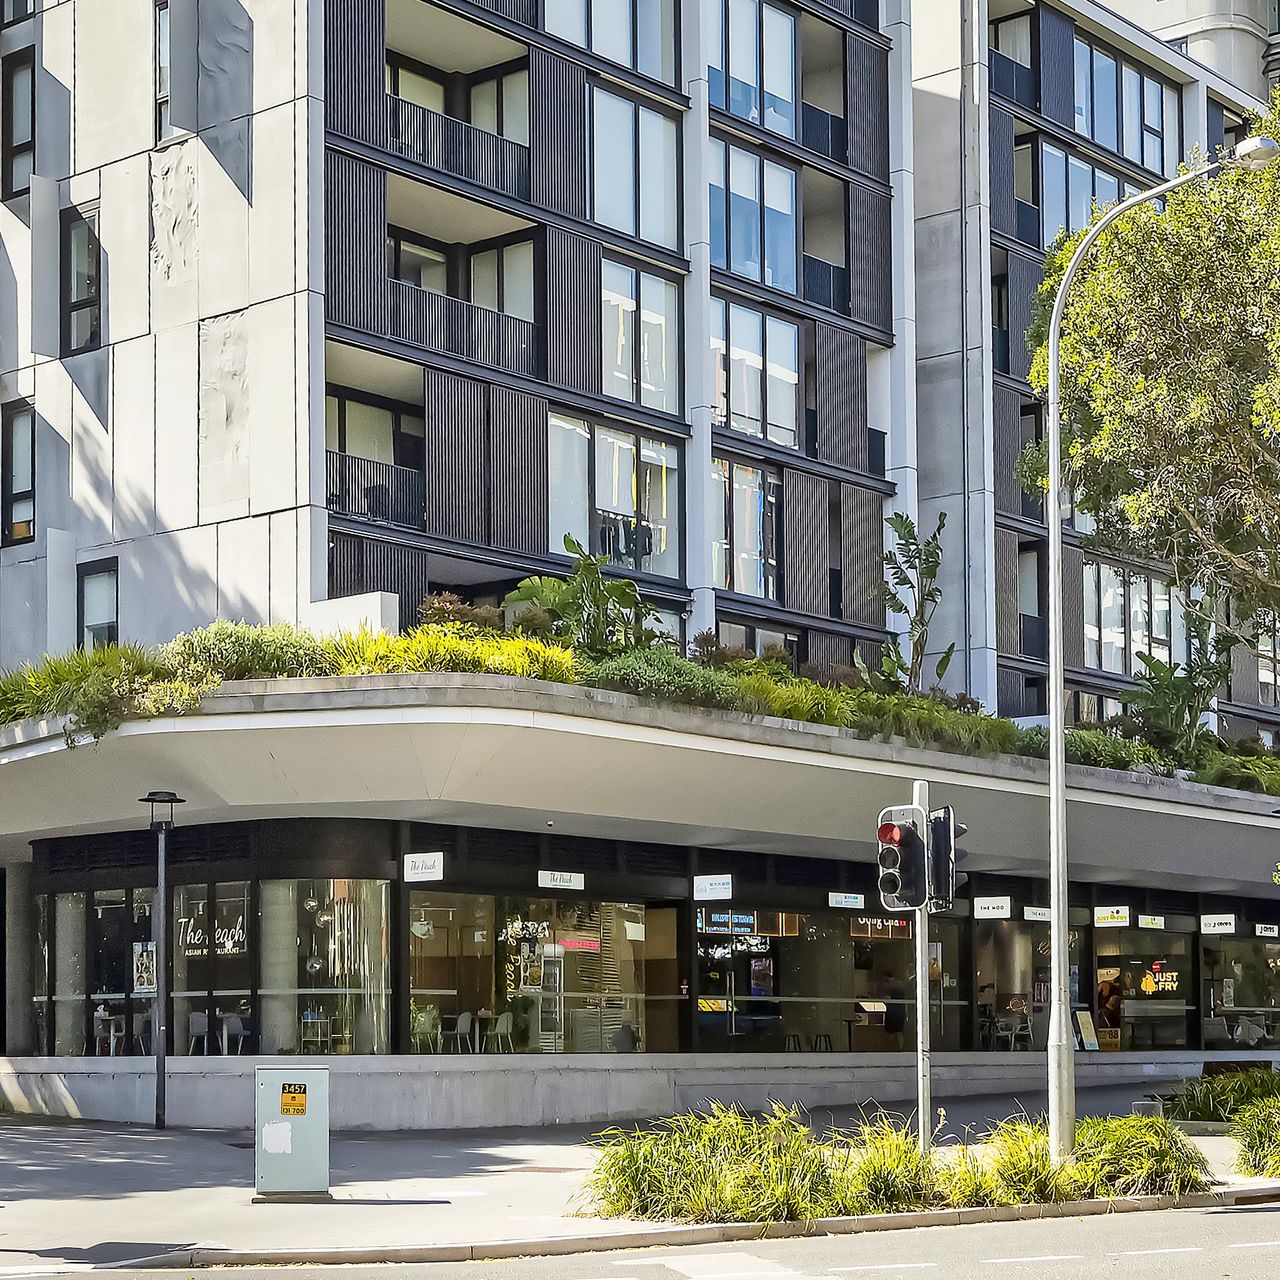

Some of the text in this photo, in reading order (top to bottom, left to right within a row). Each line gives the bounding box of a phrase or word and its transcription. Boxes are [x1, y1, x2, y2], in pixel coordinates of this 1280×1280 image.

[177, 915, 246, 947] The each
[184, 949, 202, 957] ASIAN
[1153, 971, 1178, 982] JUST
[1158, 981, 1178, 992] FRY
[283, 1084, 306, 1094] 3457
